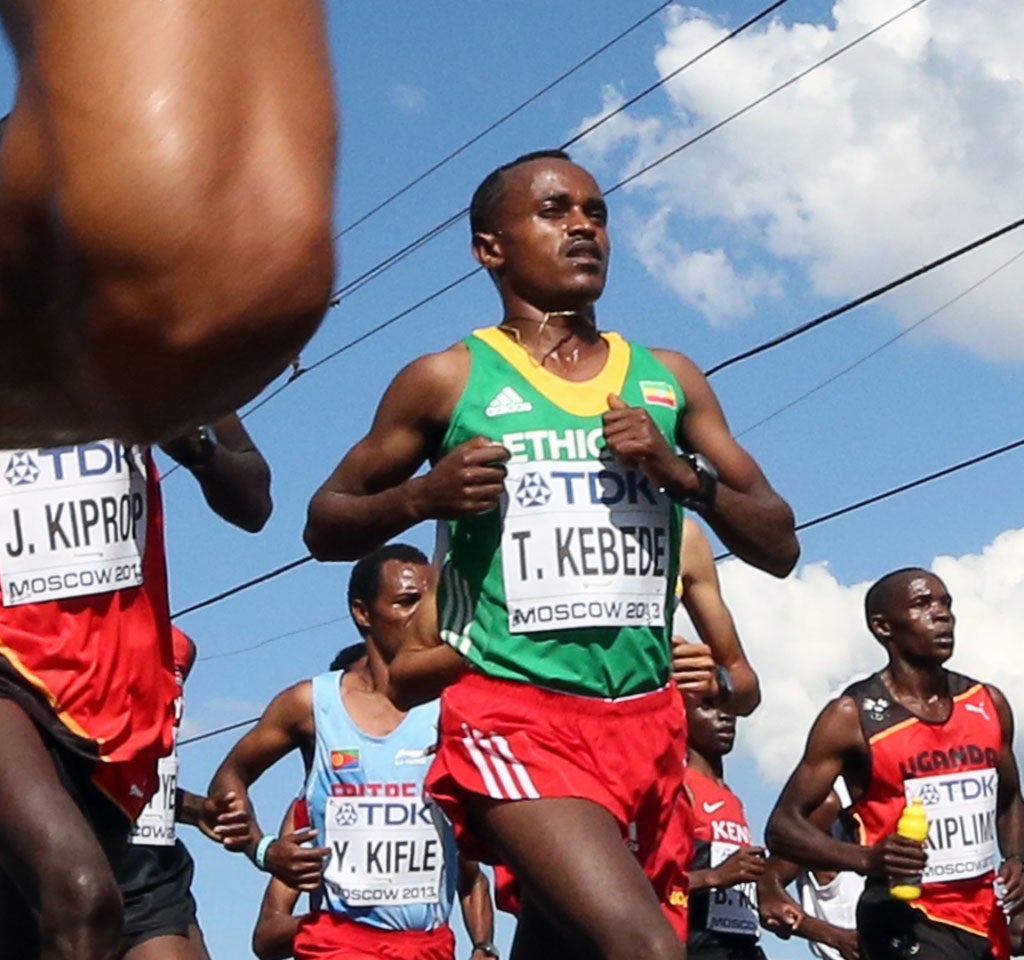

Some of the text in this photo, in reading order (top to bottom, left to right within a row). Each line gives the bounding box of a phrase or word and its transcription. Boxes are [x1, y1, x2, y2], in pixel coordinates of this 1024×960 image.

[551, 470, 658, 505] TDK
[5, 492, 144, 557] J. KIPROP
[511, 526, 665, 581] T. KEBEDE
[9, 567, 112, 598] MOSCOW
[514, 602, 624, 624] MOSCOW
[898, 744, 998, 777] UGANDA
[939, 774, 995, 801] TDK
[358, 803, 434, 826] TDK
[927, 809, 995, 851] KIPLIM
[711, 820, 752, 844] KEN
[333, 839, 437, 874] Y. KIFLE
[338, 886, 437, 900] OSCOW 2013
